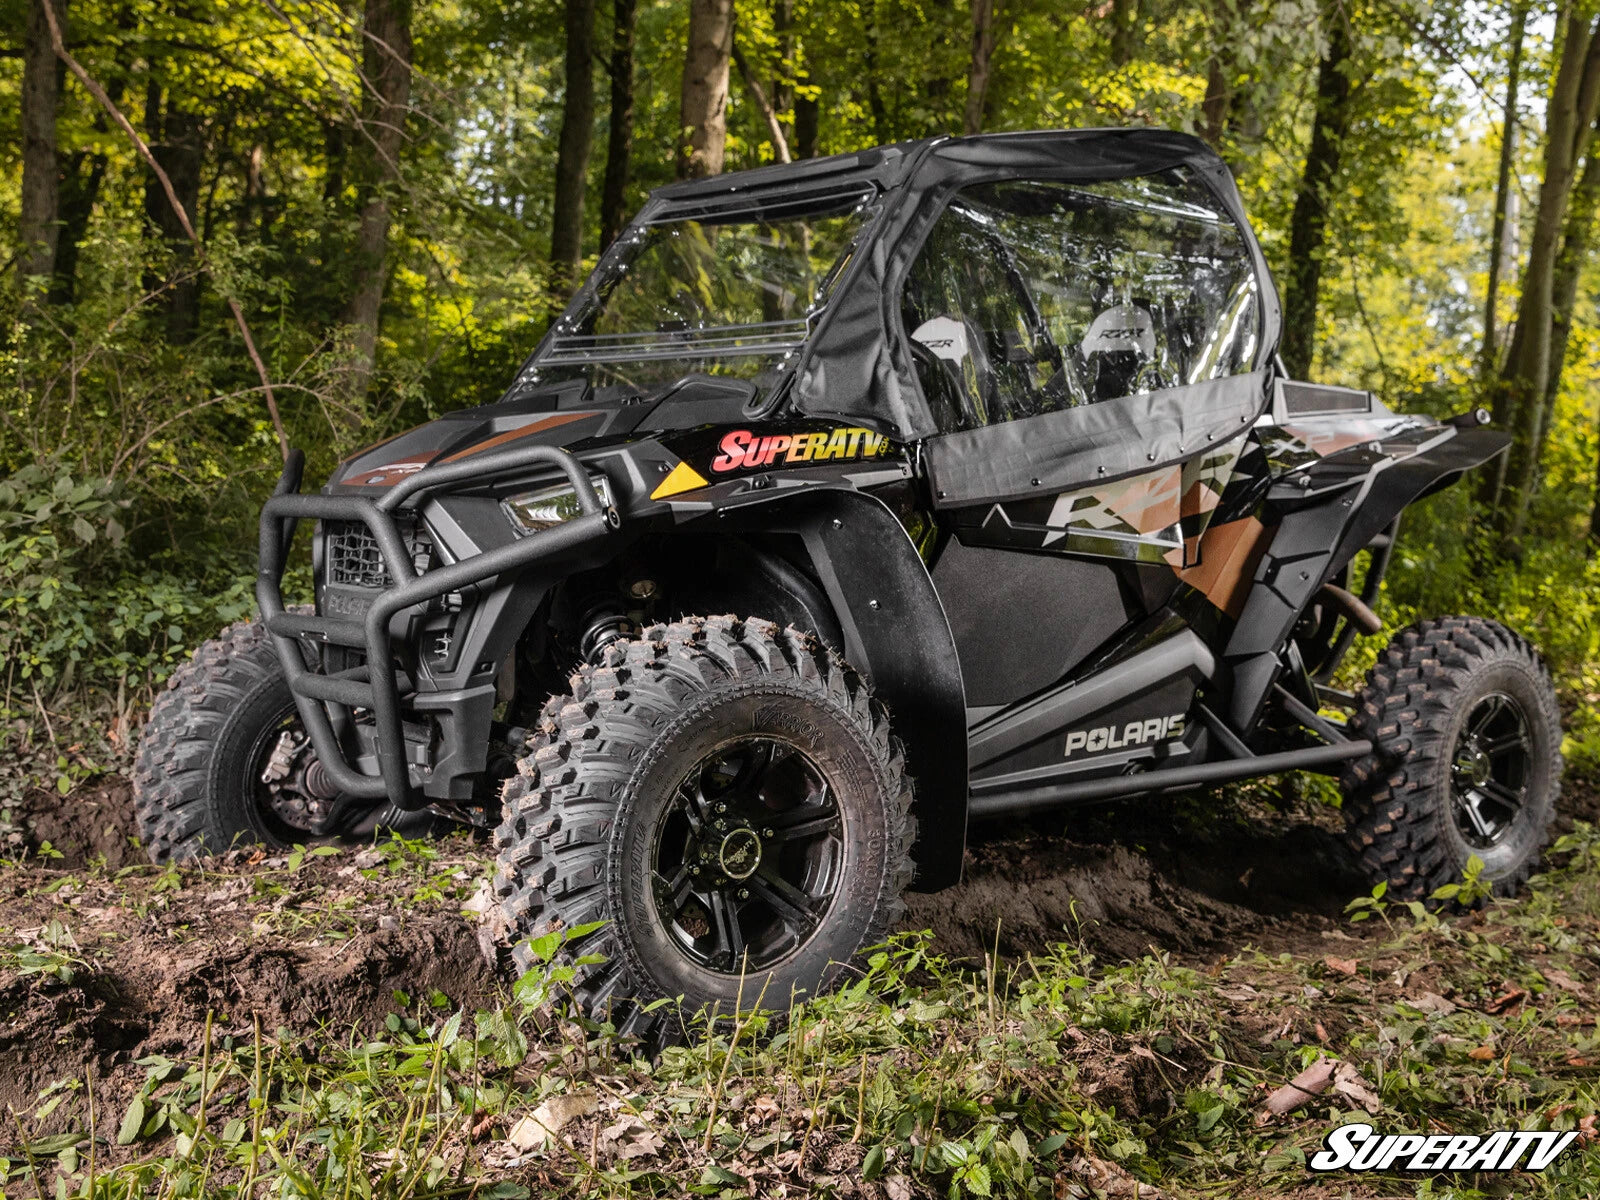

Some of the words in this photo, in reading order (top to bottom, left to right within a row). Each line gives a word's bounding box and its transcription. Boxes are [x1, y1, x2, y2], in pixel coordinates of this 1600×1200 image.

[712, 427, 884, 472] SUPERATV
[1262, 431, 1335, 459] XP
[1064, 713, 1186, 757] POLARIS
